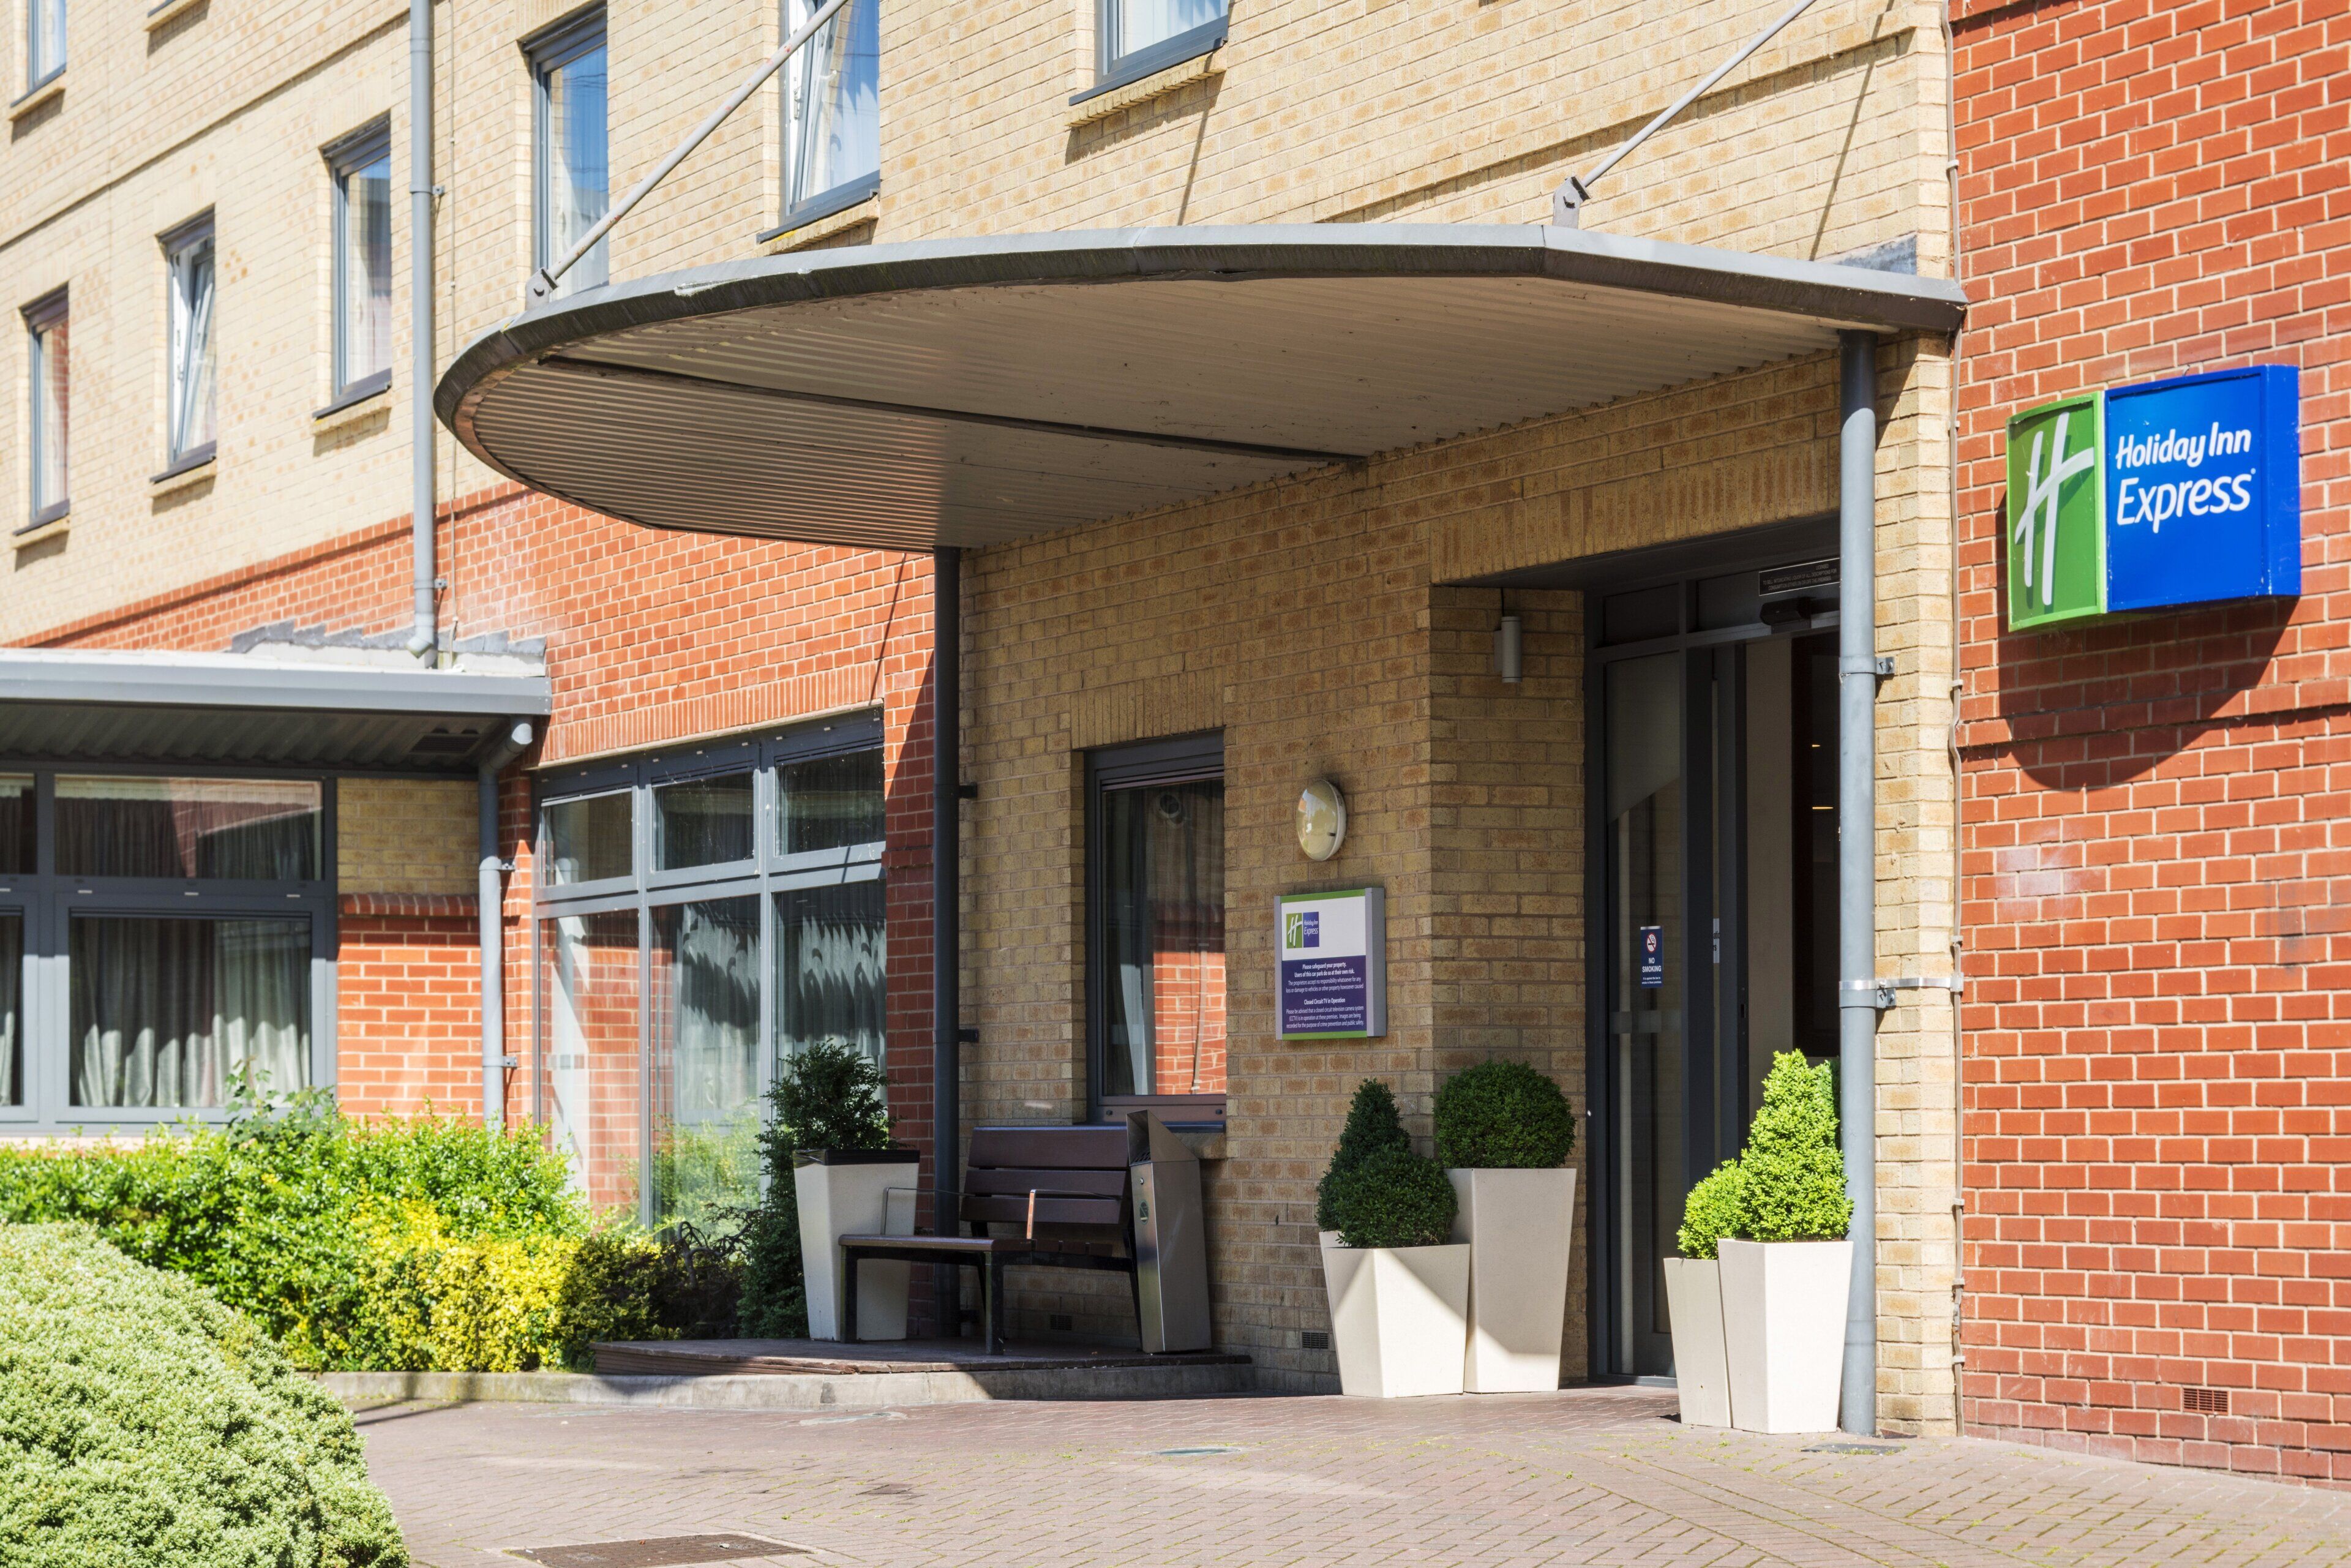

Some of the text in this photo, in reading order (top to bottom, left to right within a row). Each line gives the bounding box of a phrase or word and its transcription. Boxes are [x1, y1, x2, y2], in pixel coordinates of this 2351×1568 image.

[2115, 422, 2252, 470] Holiday Inn
[1304, 927, 1318, 937] Express
